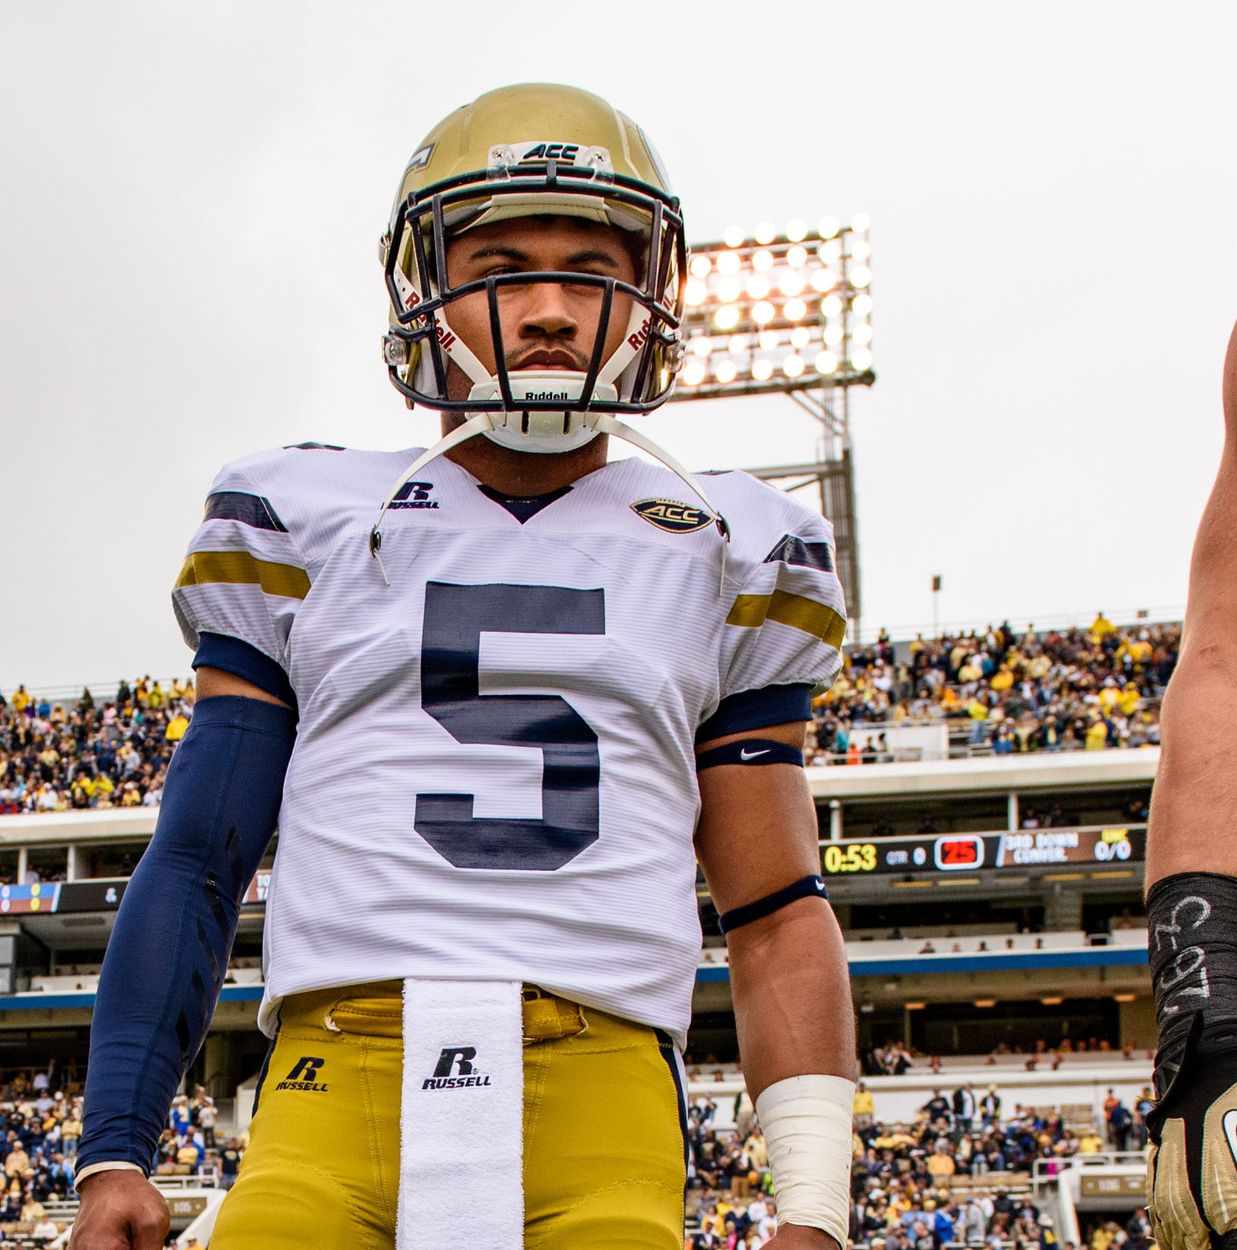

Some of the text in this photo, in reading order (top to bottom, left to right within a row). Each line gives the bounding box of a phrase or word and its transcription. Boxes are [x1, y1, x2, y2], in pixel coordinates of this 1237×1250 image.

[523, 144, 579, 160] ACC
[525, 391, 568, 401] Riddell
[643, 505, 701, 521] ACC
[414, 580, 606, 871] 5
[825, 844, 877, 873] 0:53
[944, 841, 977, 864] 25
[1095, 840, 1131, 861] 0/0
[275, 1081, 329, 1092] RUSSELL
[422, 1075, 492, 1090] RUSSELL
